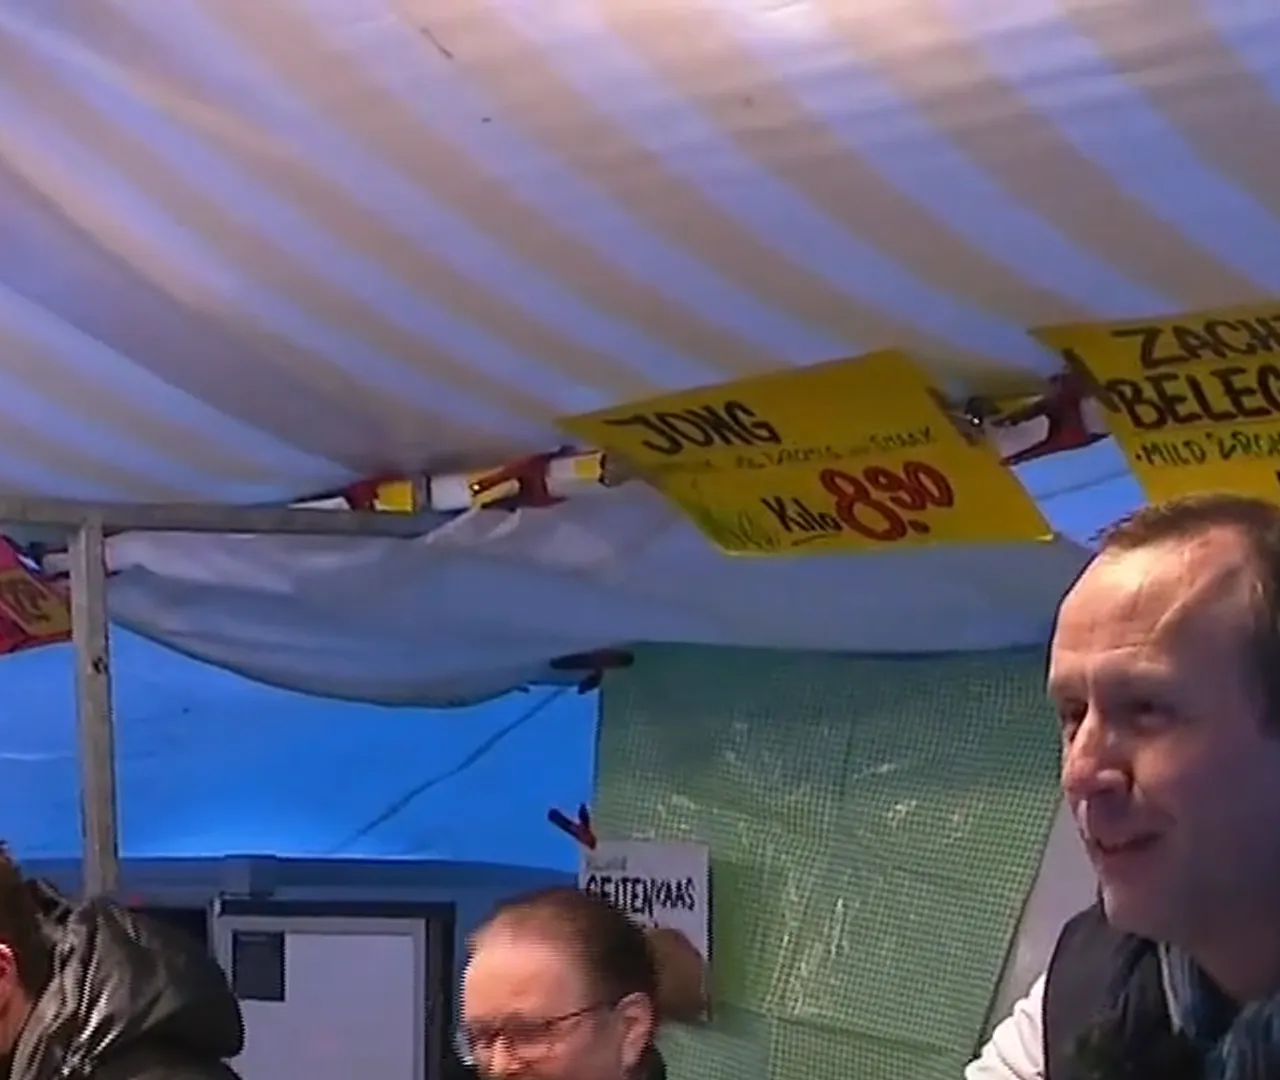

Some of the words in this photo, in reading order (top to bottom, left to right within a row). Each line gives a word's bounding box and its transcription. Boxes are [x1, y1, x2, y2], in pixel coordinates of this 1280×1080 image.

[602, 400, 781, 456] JONG
[1140, 440, 1207, 466] MILD
[760, 495, 843, 534] Kilo
[818, 460, 955, 542] 8.90
